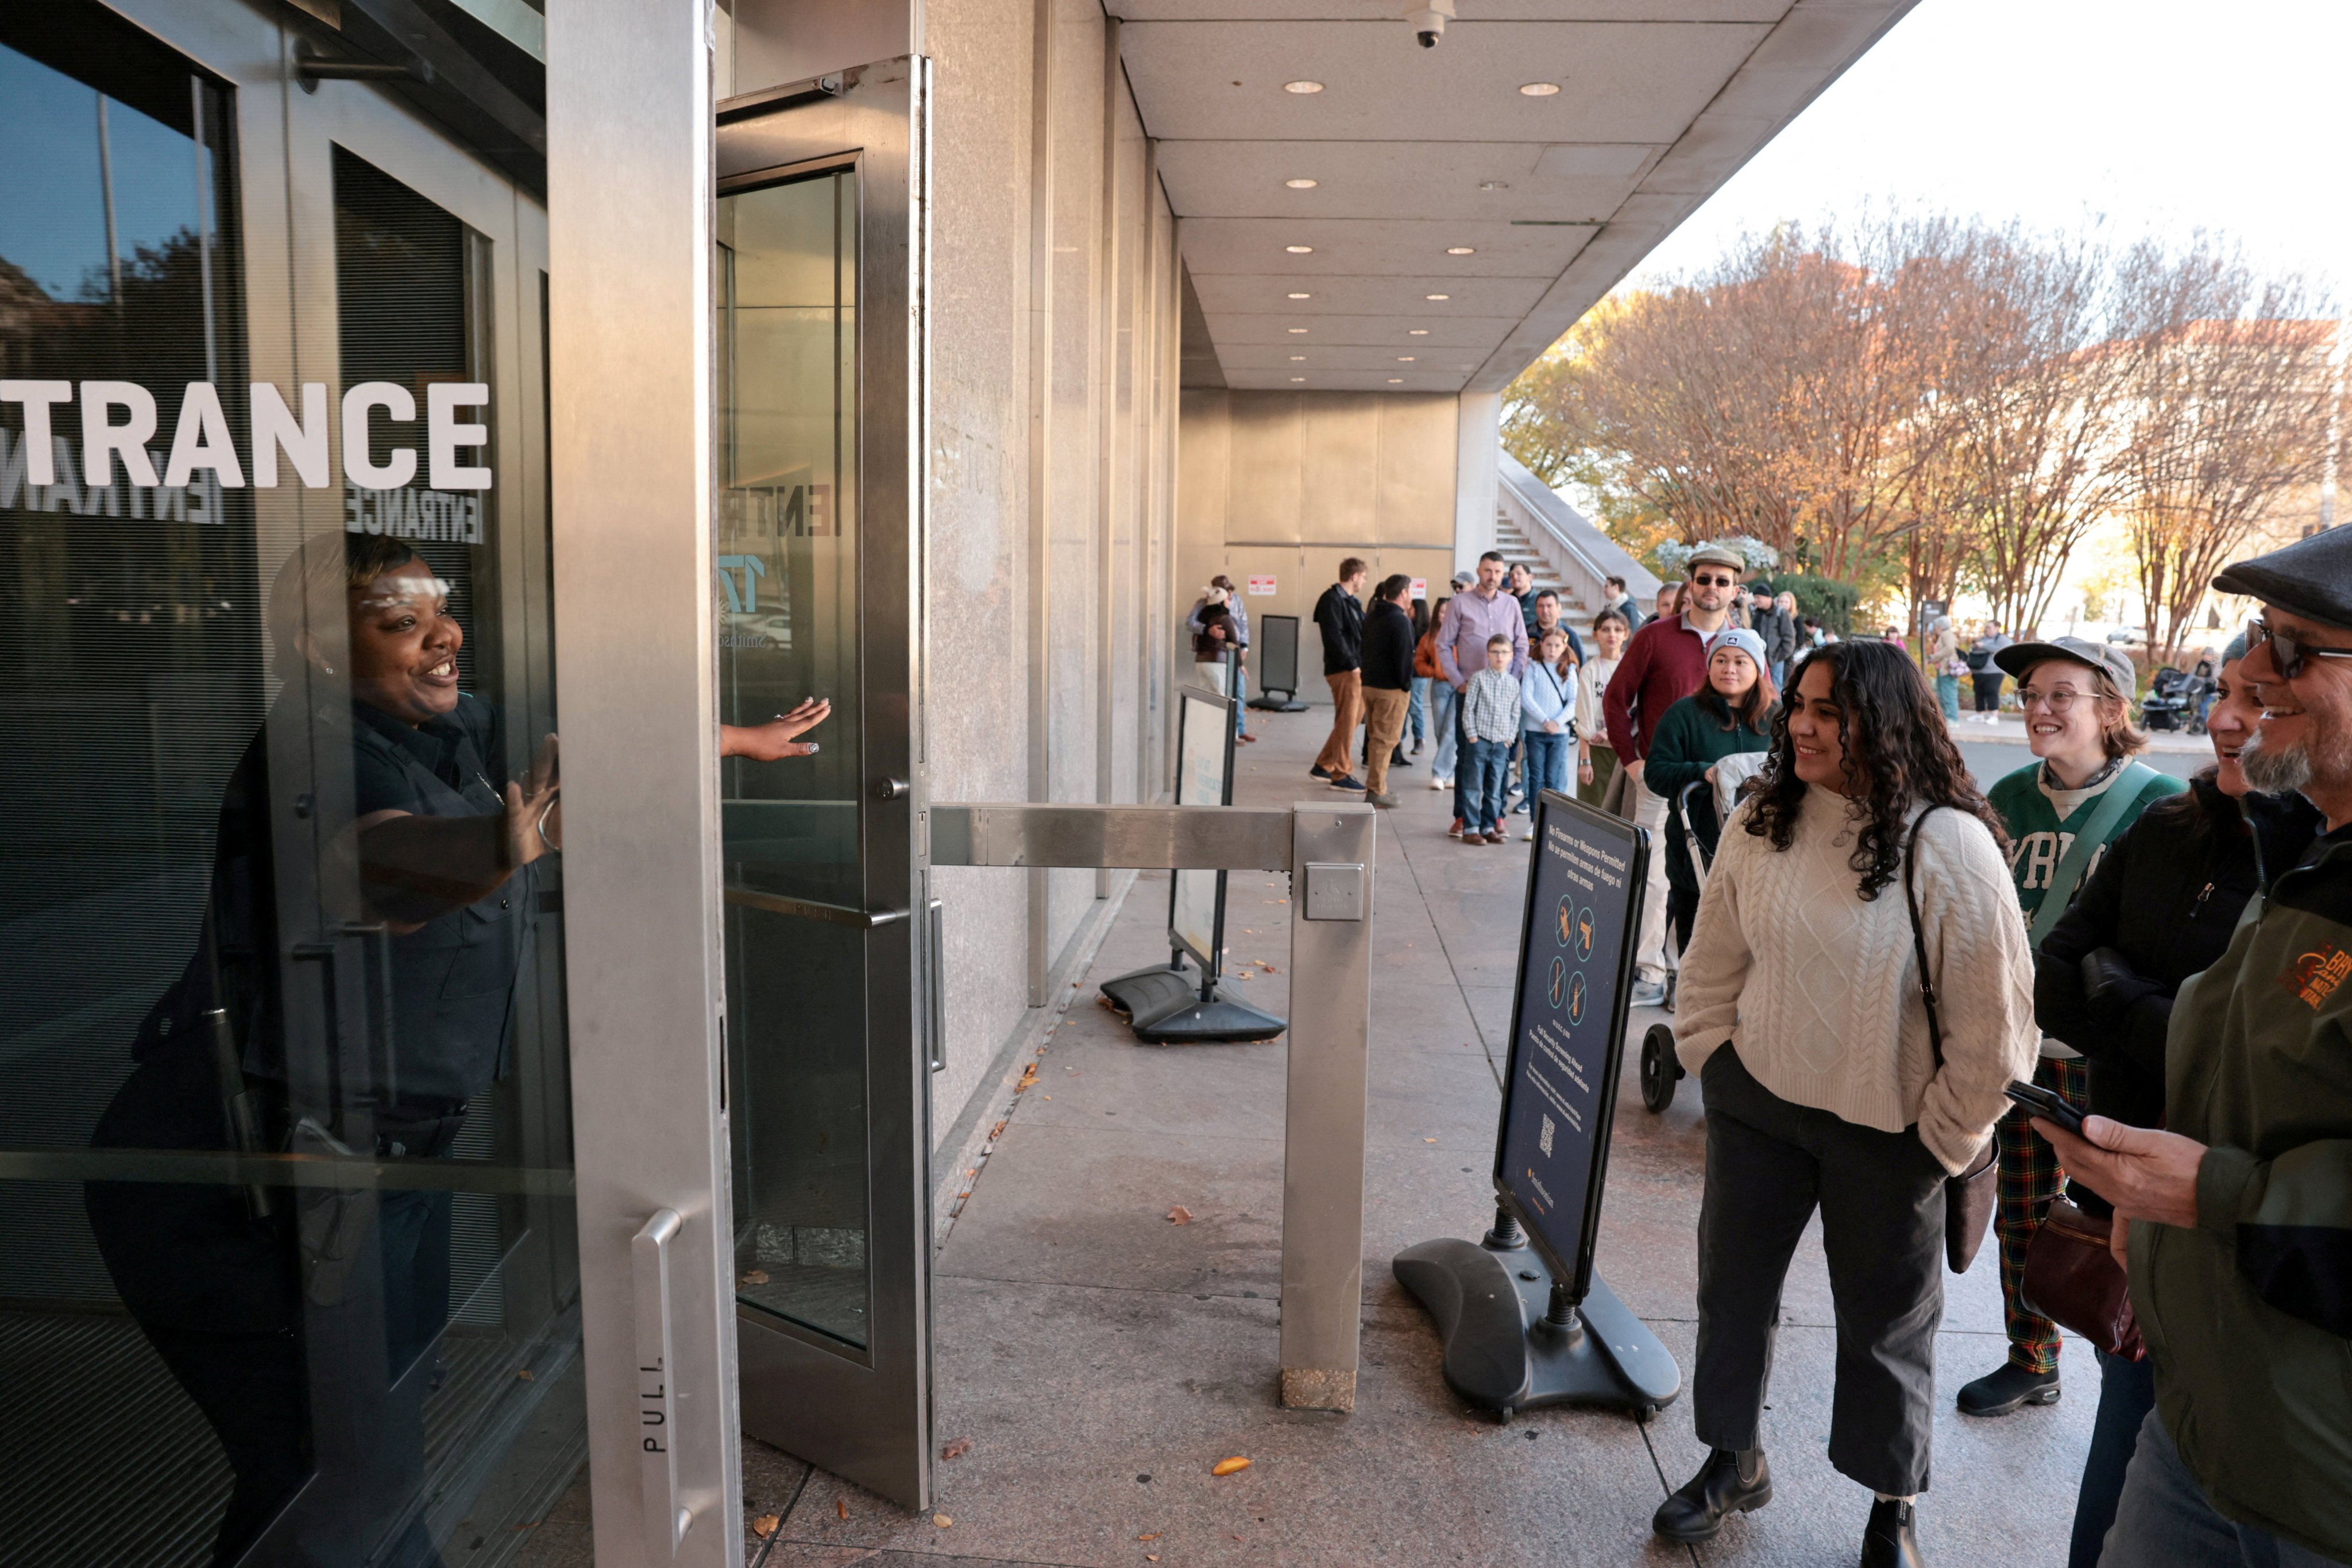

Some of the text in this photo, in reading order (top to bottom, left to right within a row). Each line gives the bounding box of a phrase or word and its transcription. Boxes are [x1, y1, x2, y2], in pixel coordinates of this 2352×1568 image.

[0, 380, 492, 489] TRANCE
[1548, 840, 1622, 889] No se permiten armas de fuego ni
[1549, 824, 1625, 872] No Firearms or Weapons Permitted
[1567, 869, 1594, 891] otras armas
[1531, 1172, 1554, 1208] Smithsonian
[640, 1357, 666, 1452] PULL
